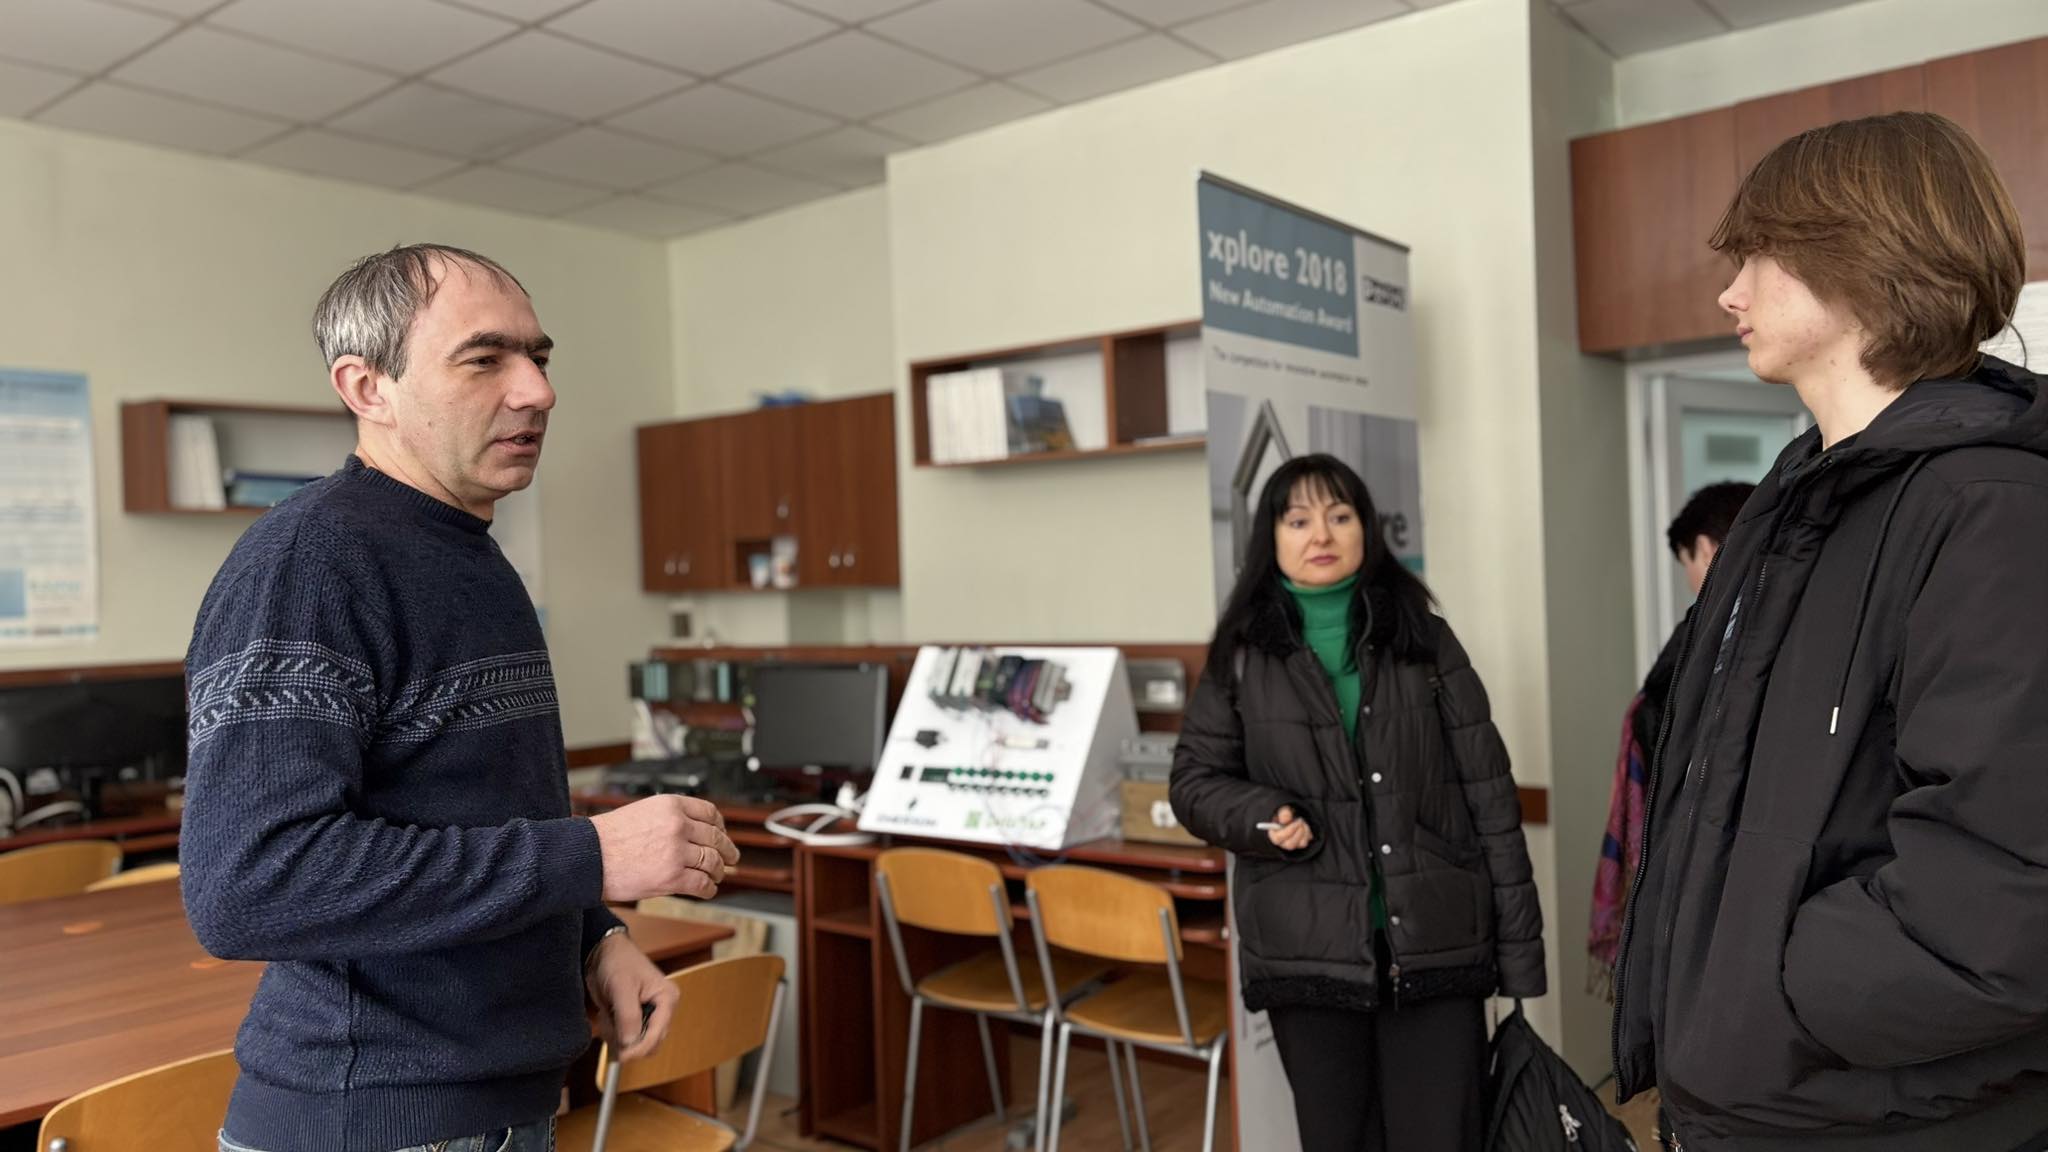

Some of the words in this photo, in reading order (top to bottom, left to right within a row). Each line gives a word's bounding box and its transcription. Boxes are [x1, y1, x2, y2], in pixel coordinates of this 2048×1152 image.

[1207, 229, 1290, 279] xplore
[1295, 246, 1348, 297] 2018
[1209, 279, 1240, 306] New
[1241, 289, 1316, 325] Automation
[1317, 308, 1353, 335] Award
